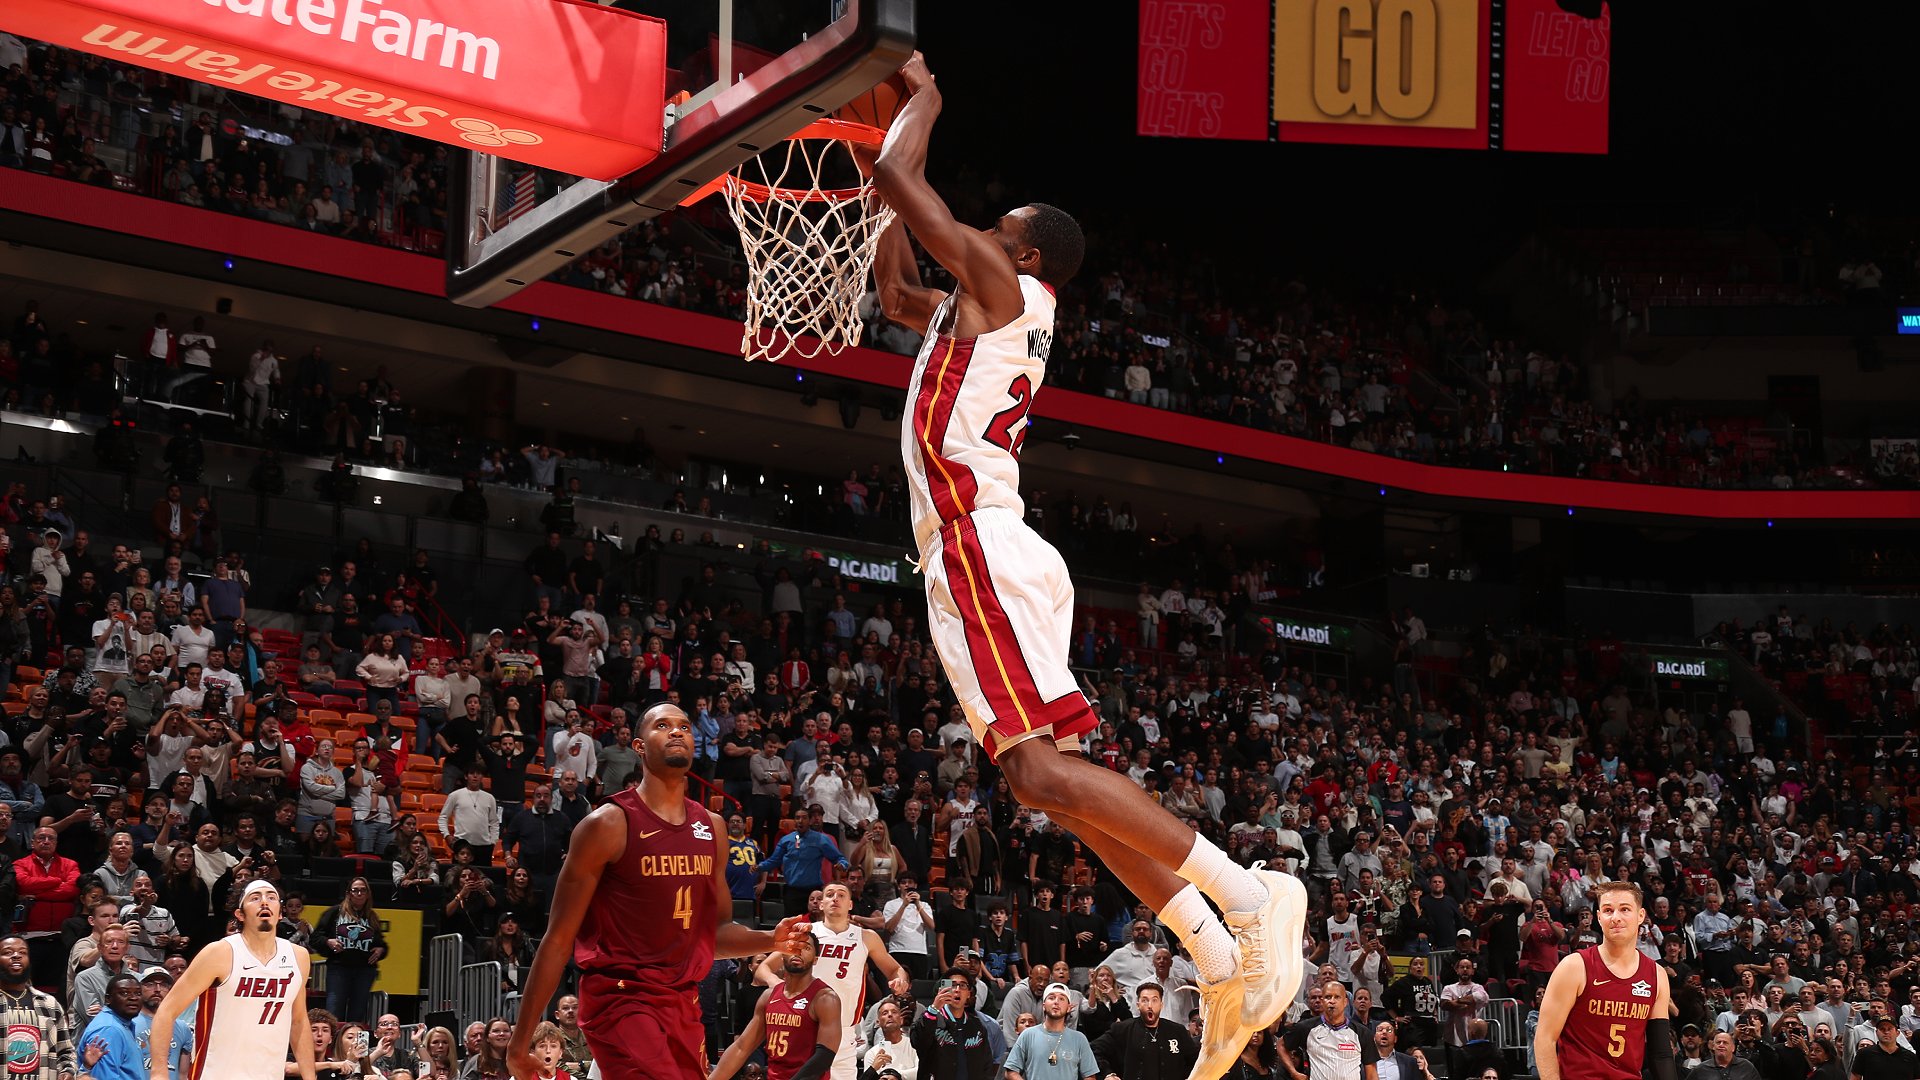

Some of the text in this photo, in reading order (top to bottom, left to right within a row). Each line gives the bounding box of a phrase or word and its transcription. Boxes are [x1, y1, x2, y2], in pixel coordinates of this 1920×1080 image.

[1140, 1, 1226, 49] LET'S
[1141, 46, 1188, 92] GO
[1313, 0, 1438, 121] GO
[82, 23, 450, 128] StateFarm
[1565, 57, 1609, 103] GO
[1139, 90, 1225, 138] LET'S
[1276, 622, 1331, 645] BACARDÍ
[1656, 661, 1706, 677] BACARDÍ
[956, 812, 974, 820] EAT
[641, 854, 713, 876] CLEVELAND
[729, 846, 756, 866] 30
[672, 885, 693, 930] 4
[835, 961, 850, 979] 5
[234, 971, 294, 998] HEAT
[258, 1001, 284, 1024] 11
[765, 1012, 802, 1027] CLEVELAND
[1588, 998, 1650, 1020] CLEVELAND
[767, 1030, 790, 1057] 45
[1607, 1023, 1626, 1058] 5
